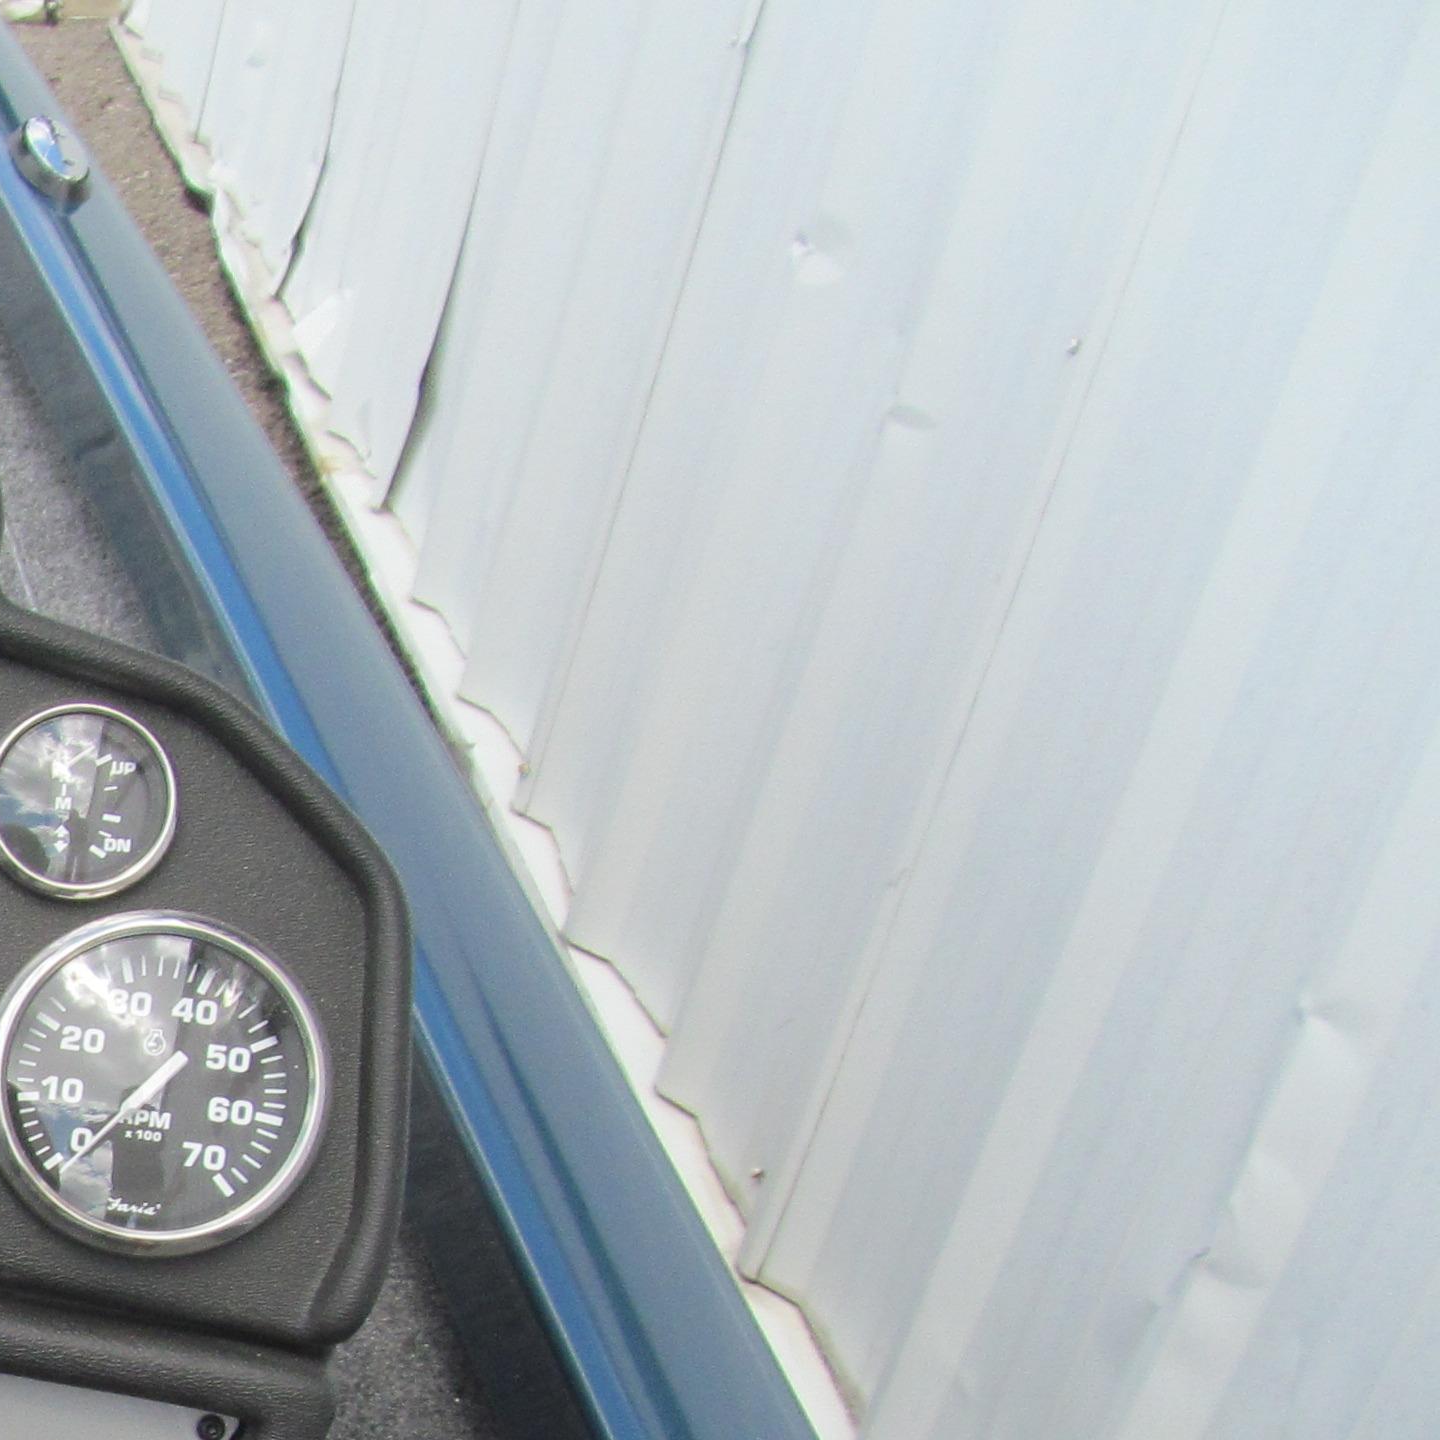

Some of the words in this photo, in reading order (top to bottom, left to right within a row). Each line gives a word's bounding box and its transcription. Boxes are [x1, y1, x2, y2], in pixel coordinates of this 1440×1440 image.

[110, 761, 137, 775] UP
[103, 838, 131, 852] DN
[171, 997, 218, 1026] 40
[59, 1025, 105, 1054] 20
[205, 1043, 251, 1073] 50
[41, 1075, 84, 1104] 10
[207, 1096, 254, 1126] 60
[70, 1127, 93, 1153] 0
[135, 1129, 162, 1142] 100
[182, 1141, 226, 1171] 70
